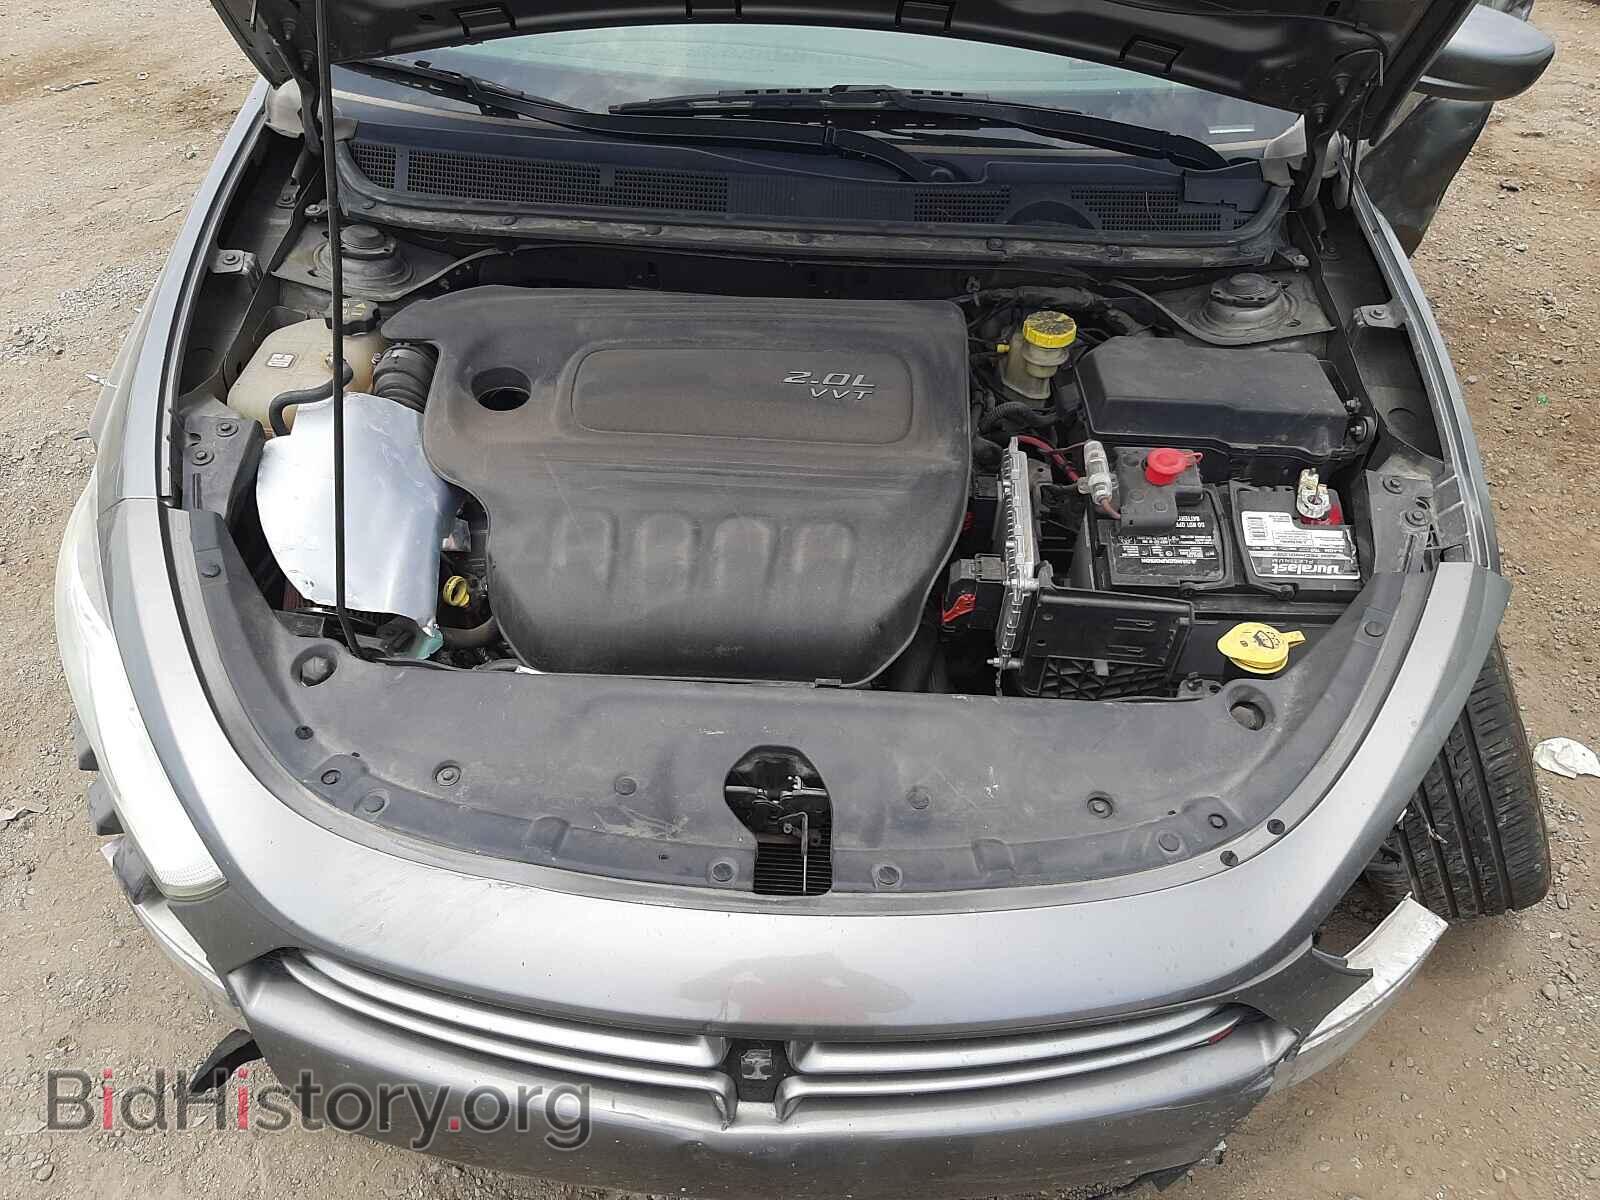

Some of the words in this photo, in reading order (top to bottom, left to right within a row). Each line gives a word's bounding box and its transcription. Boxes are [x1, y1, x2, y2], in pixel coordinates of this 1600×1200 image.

[783, 371, 875, 387] 2.0L
[810, 388, 873, 400] VVT
[1271, 563, 1342, 575] Duralast
